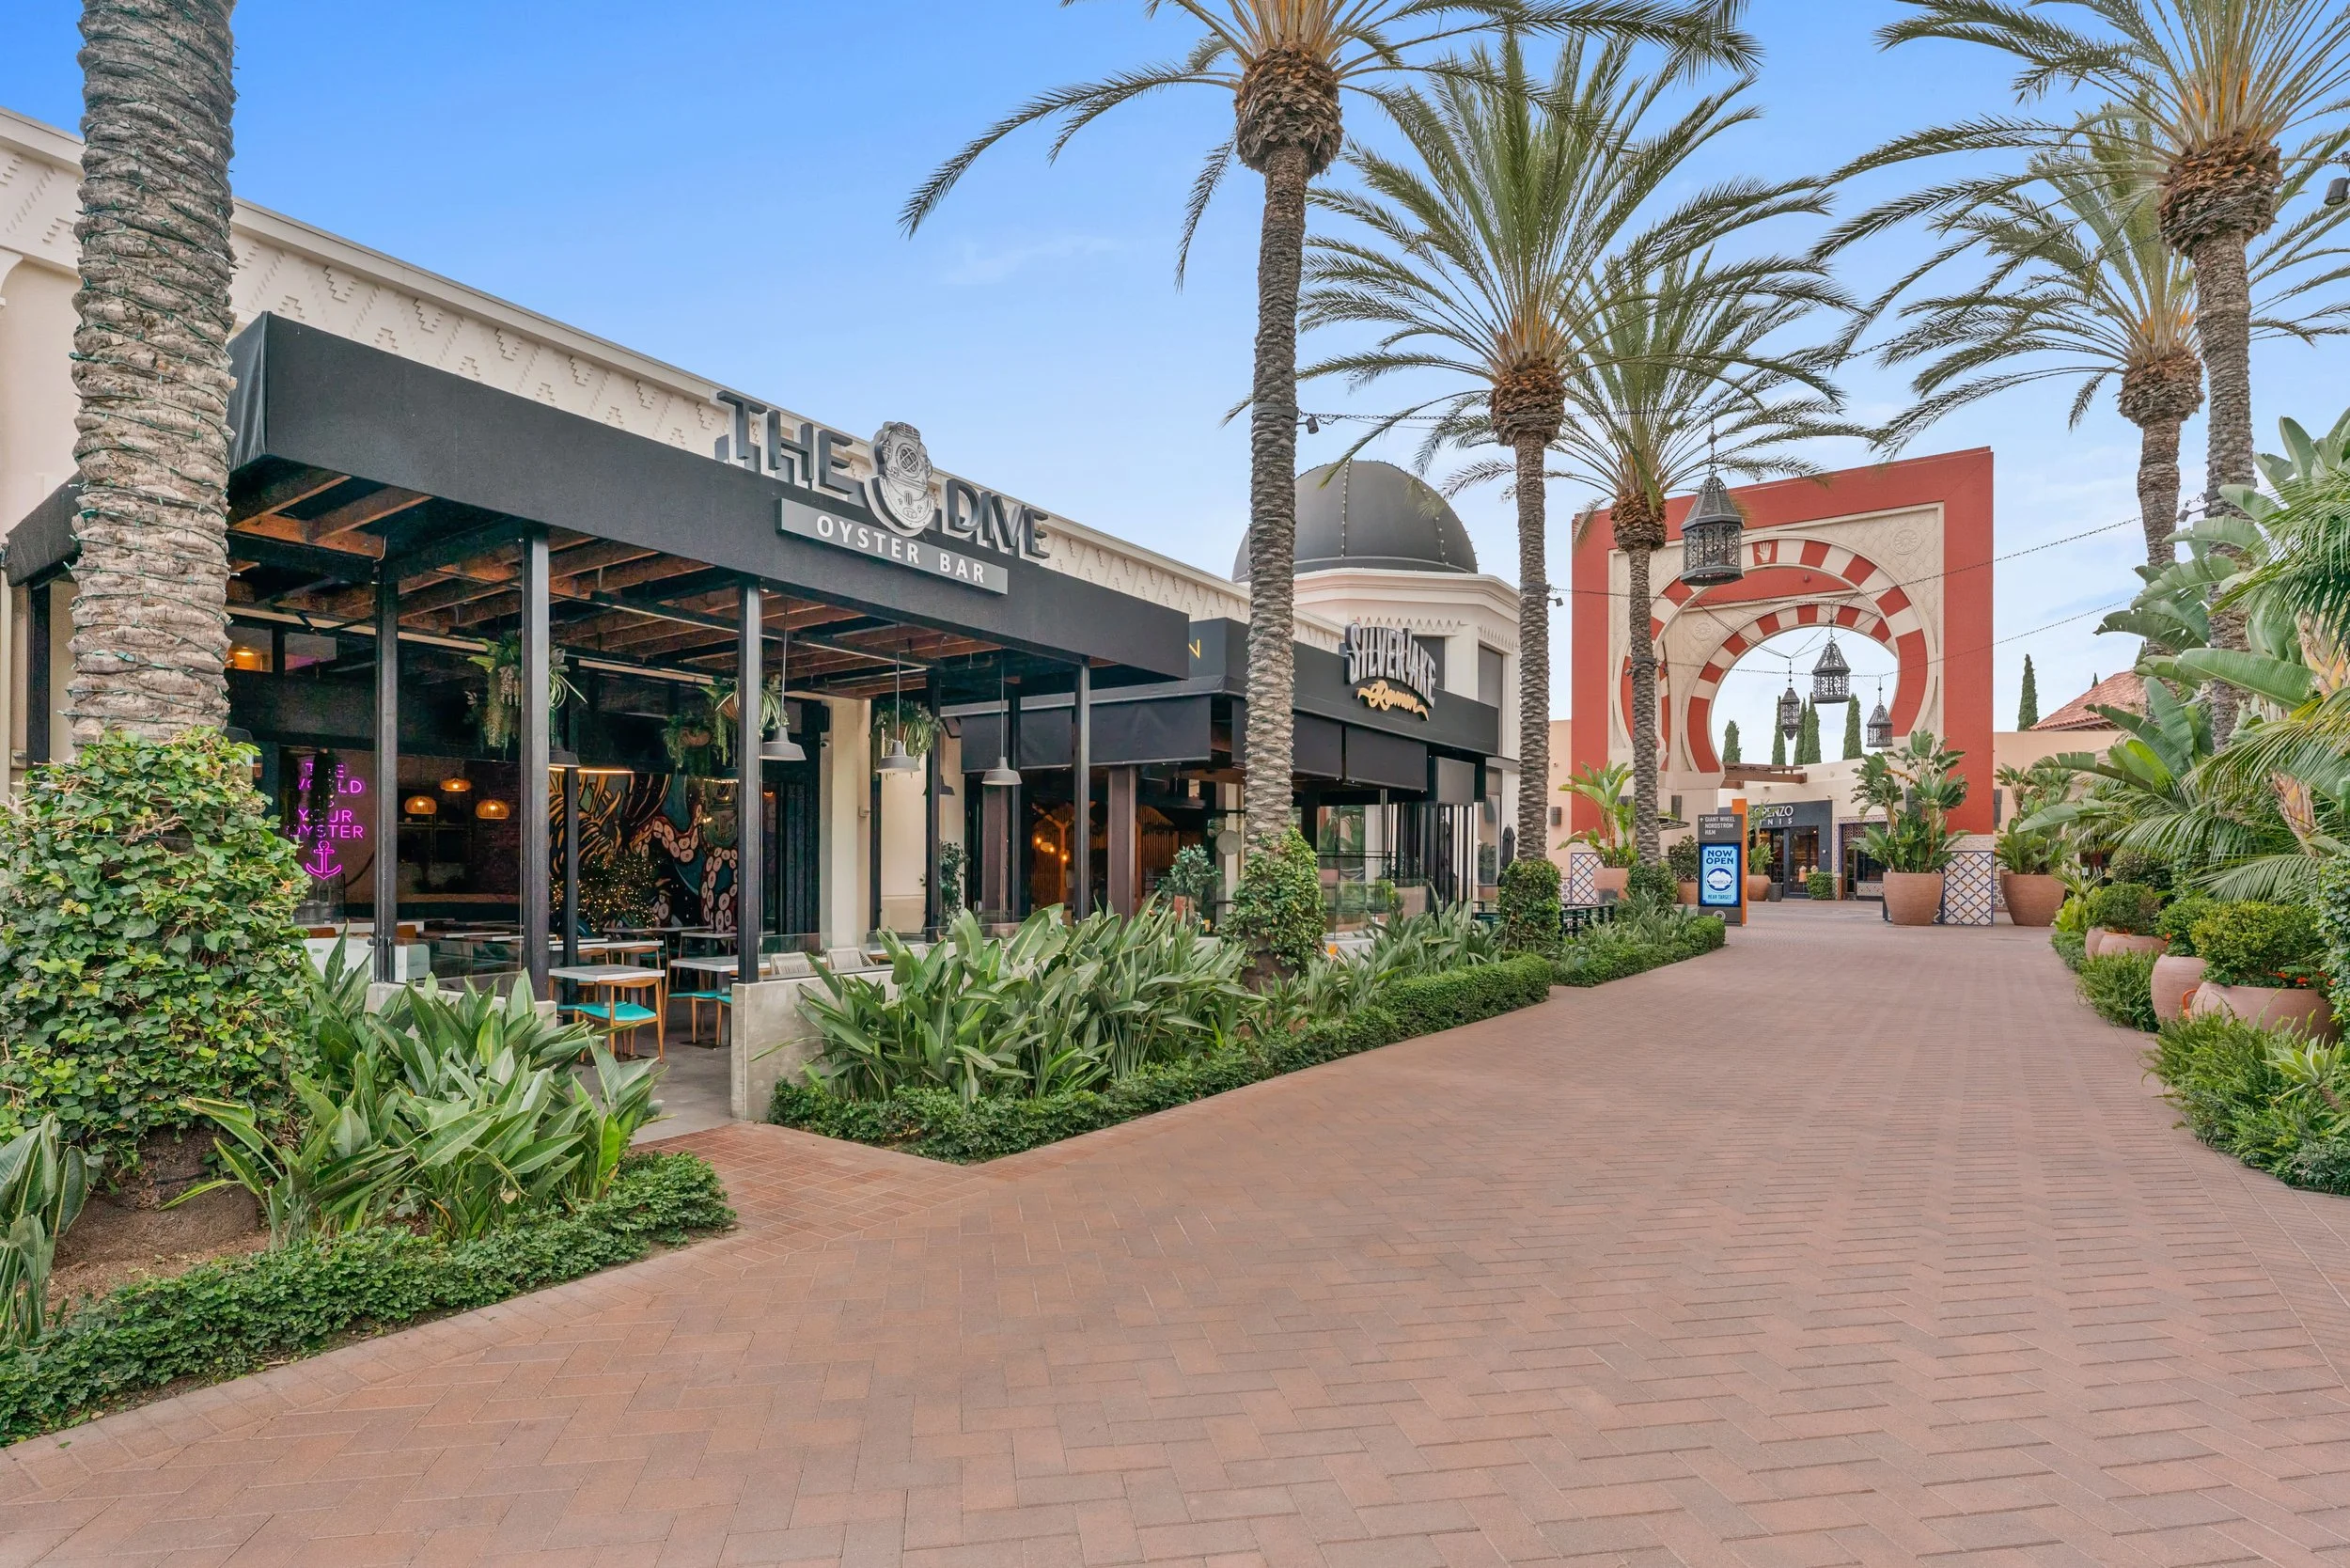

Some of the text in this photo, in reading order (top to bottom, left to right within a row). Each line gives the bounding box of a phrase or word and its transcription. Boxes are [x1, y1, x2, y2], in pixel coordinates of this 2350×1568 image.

[717, 390, 1050, 560] THE DIVE
[816, 515, 985, 584] OYSTER BAR
[1348, 622, 1436, 708] SILVERLAKE
